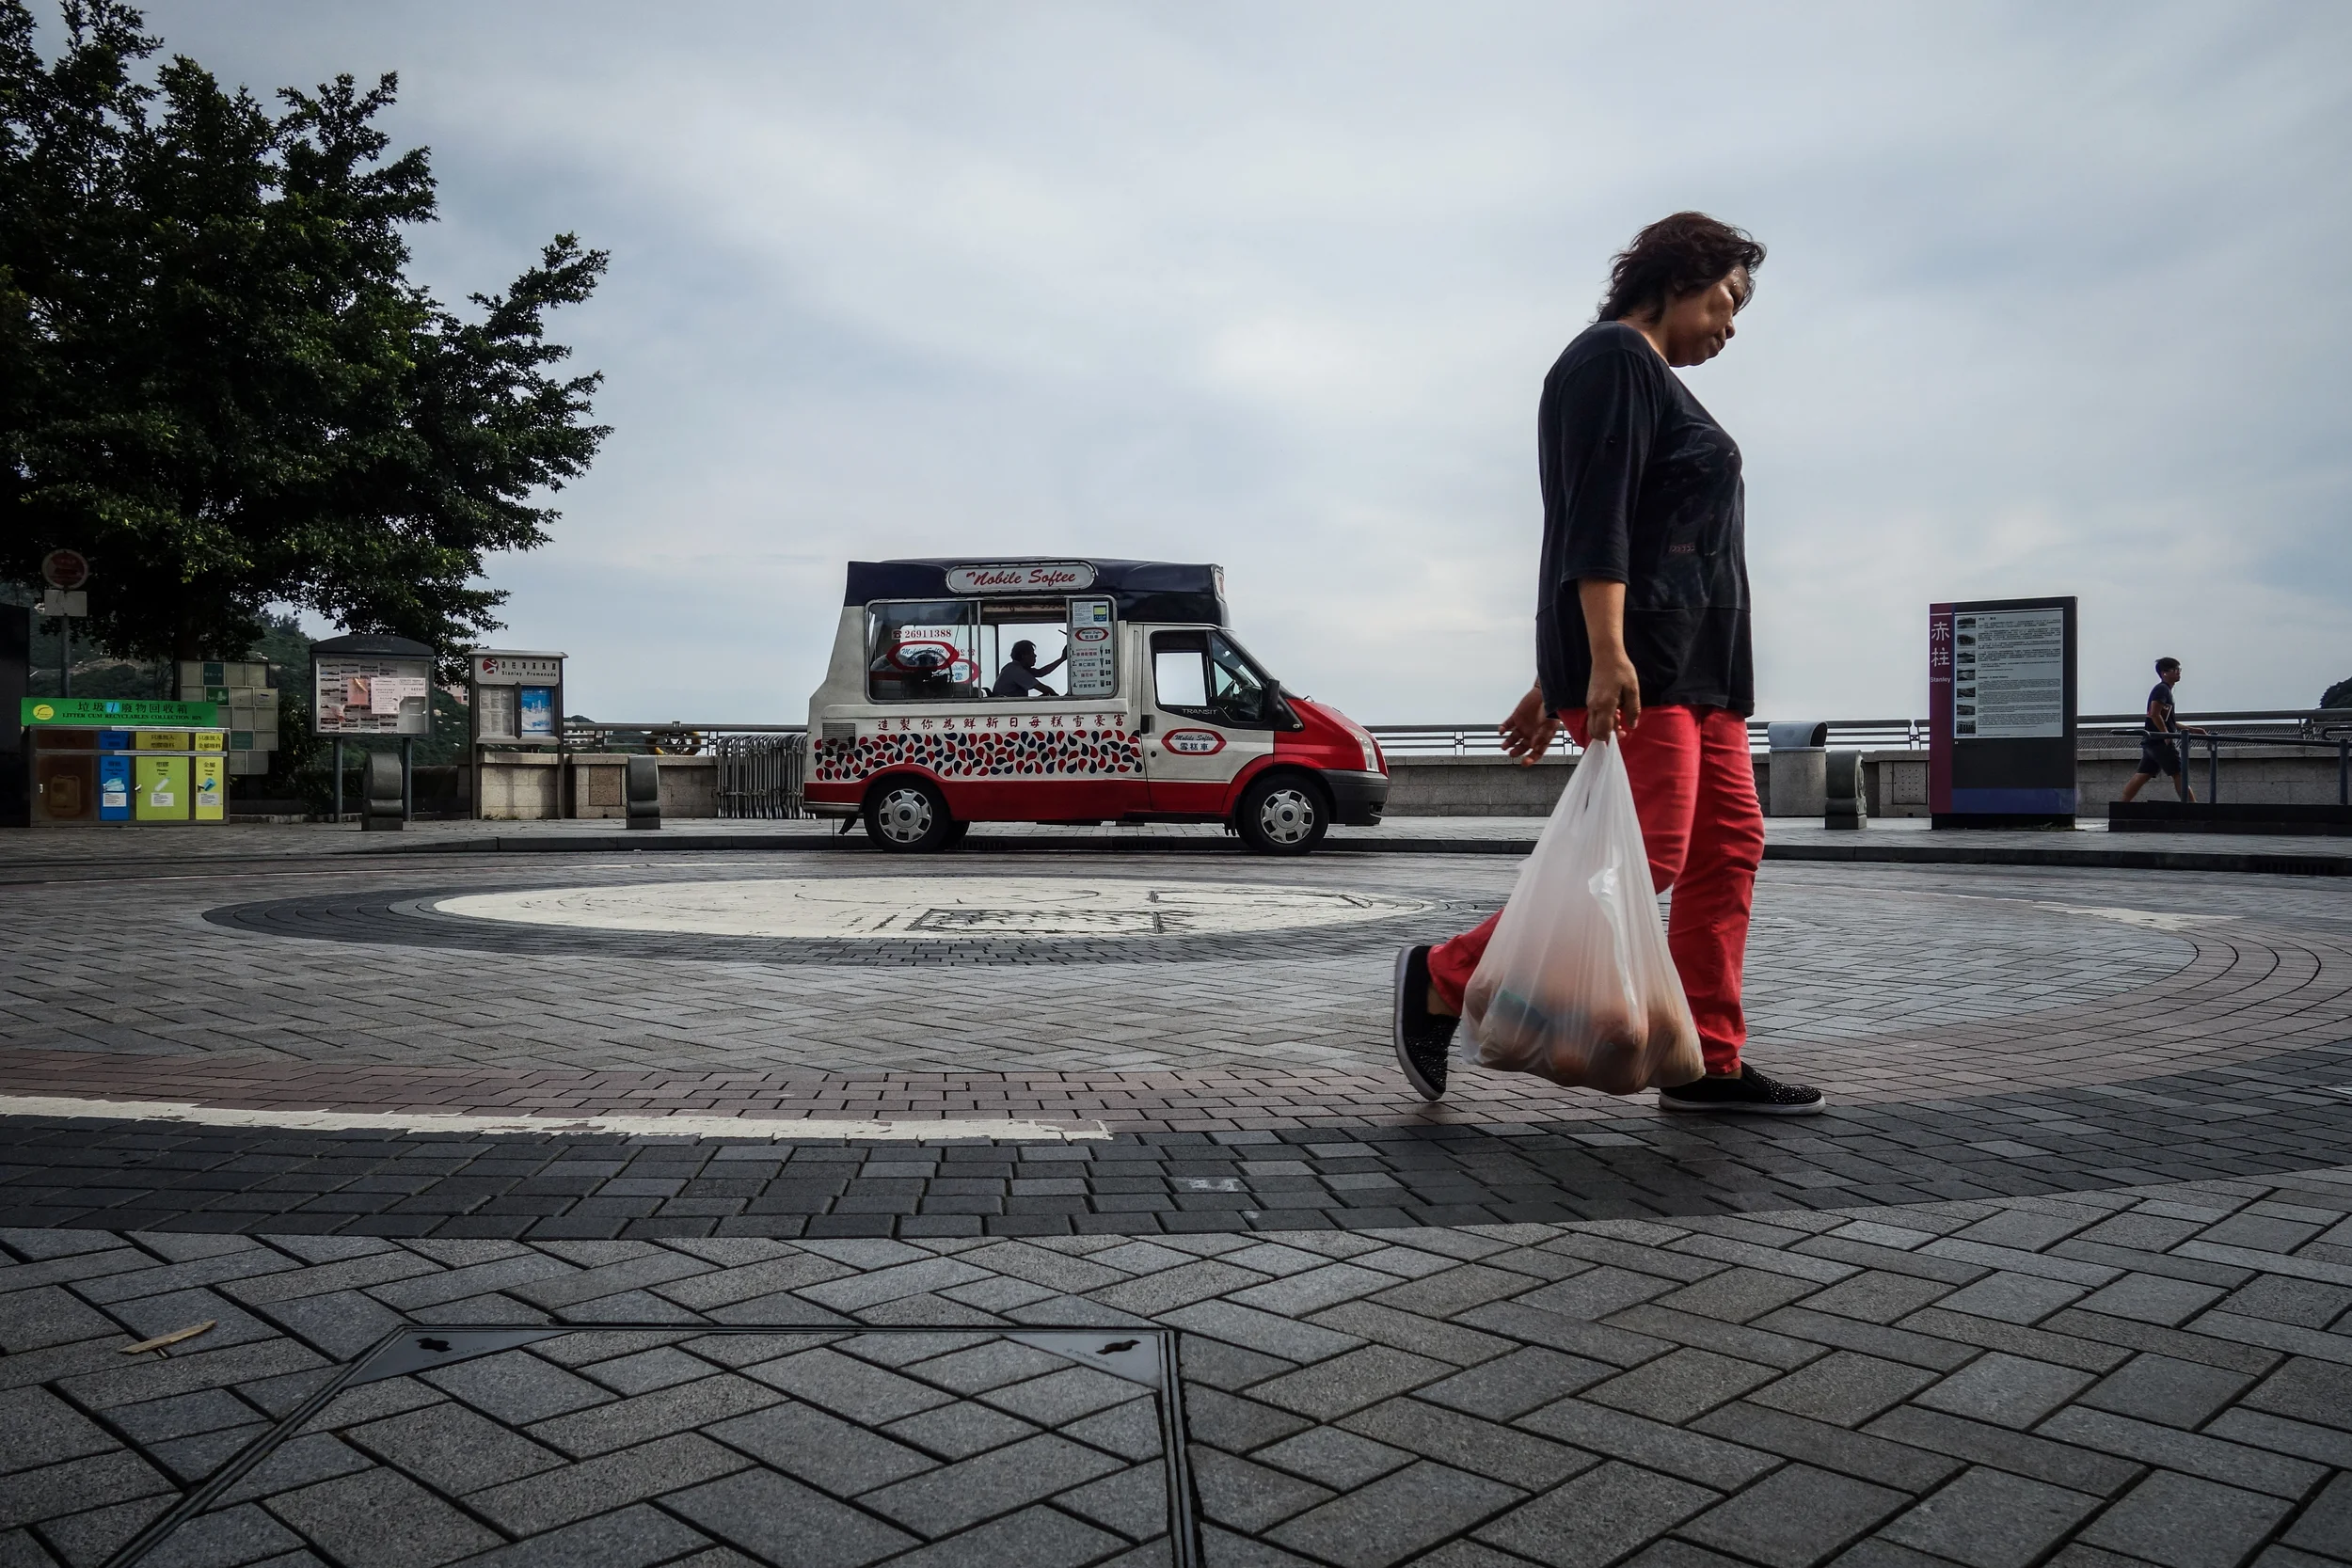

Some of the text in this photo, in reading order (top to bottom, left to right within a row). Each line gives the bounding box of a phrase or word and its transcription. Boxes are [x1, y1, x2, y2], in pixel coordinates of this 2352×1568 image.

[1028, 569, 1075, 587] Softee
[1931, 621, 1950, 667] 赤柱
[1180, 742, 1209, 751] 雪糕車
